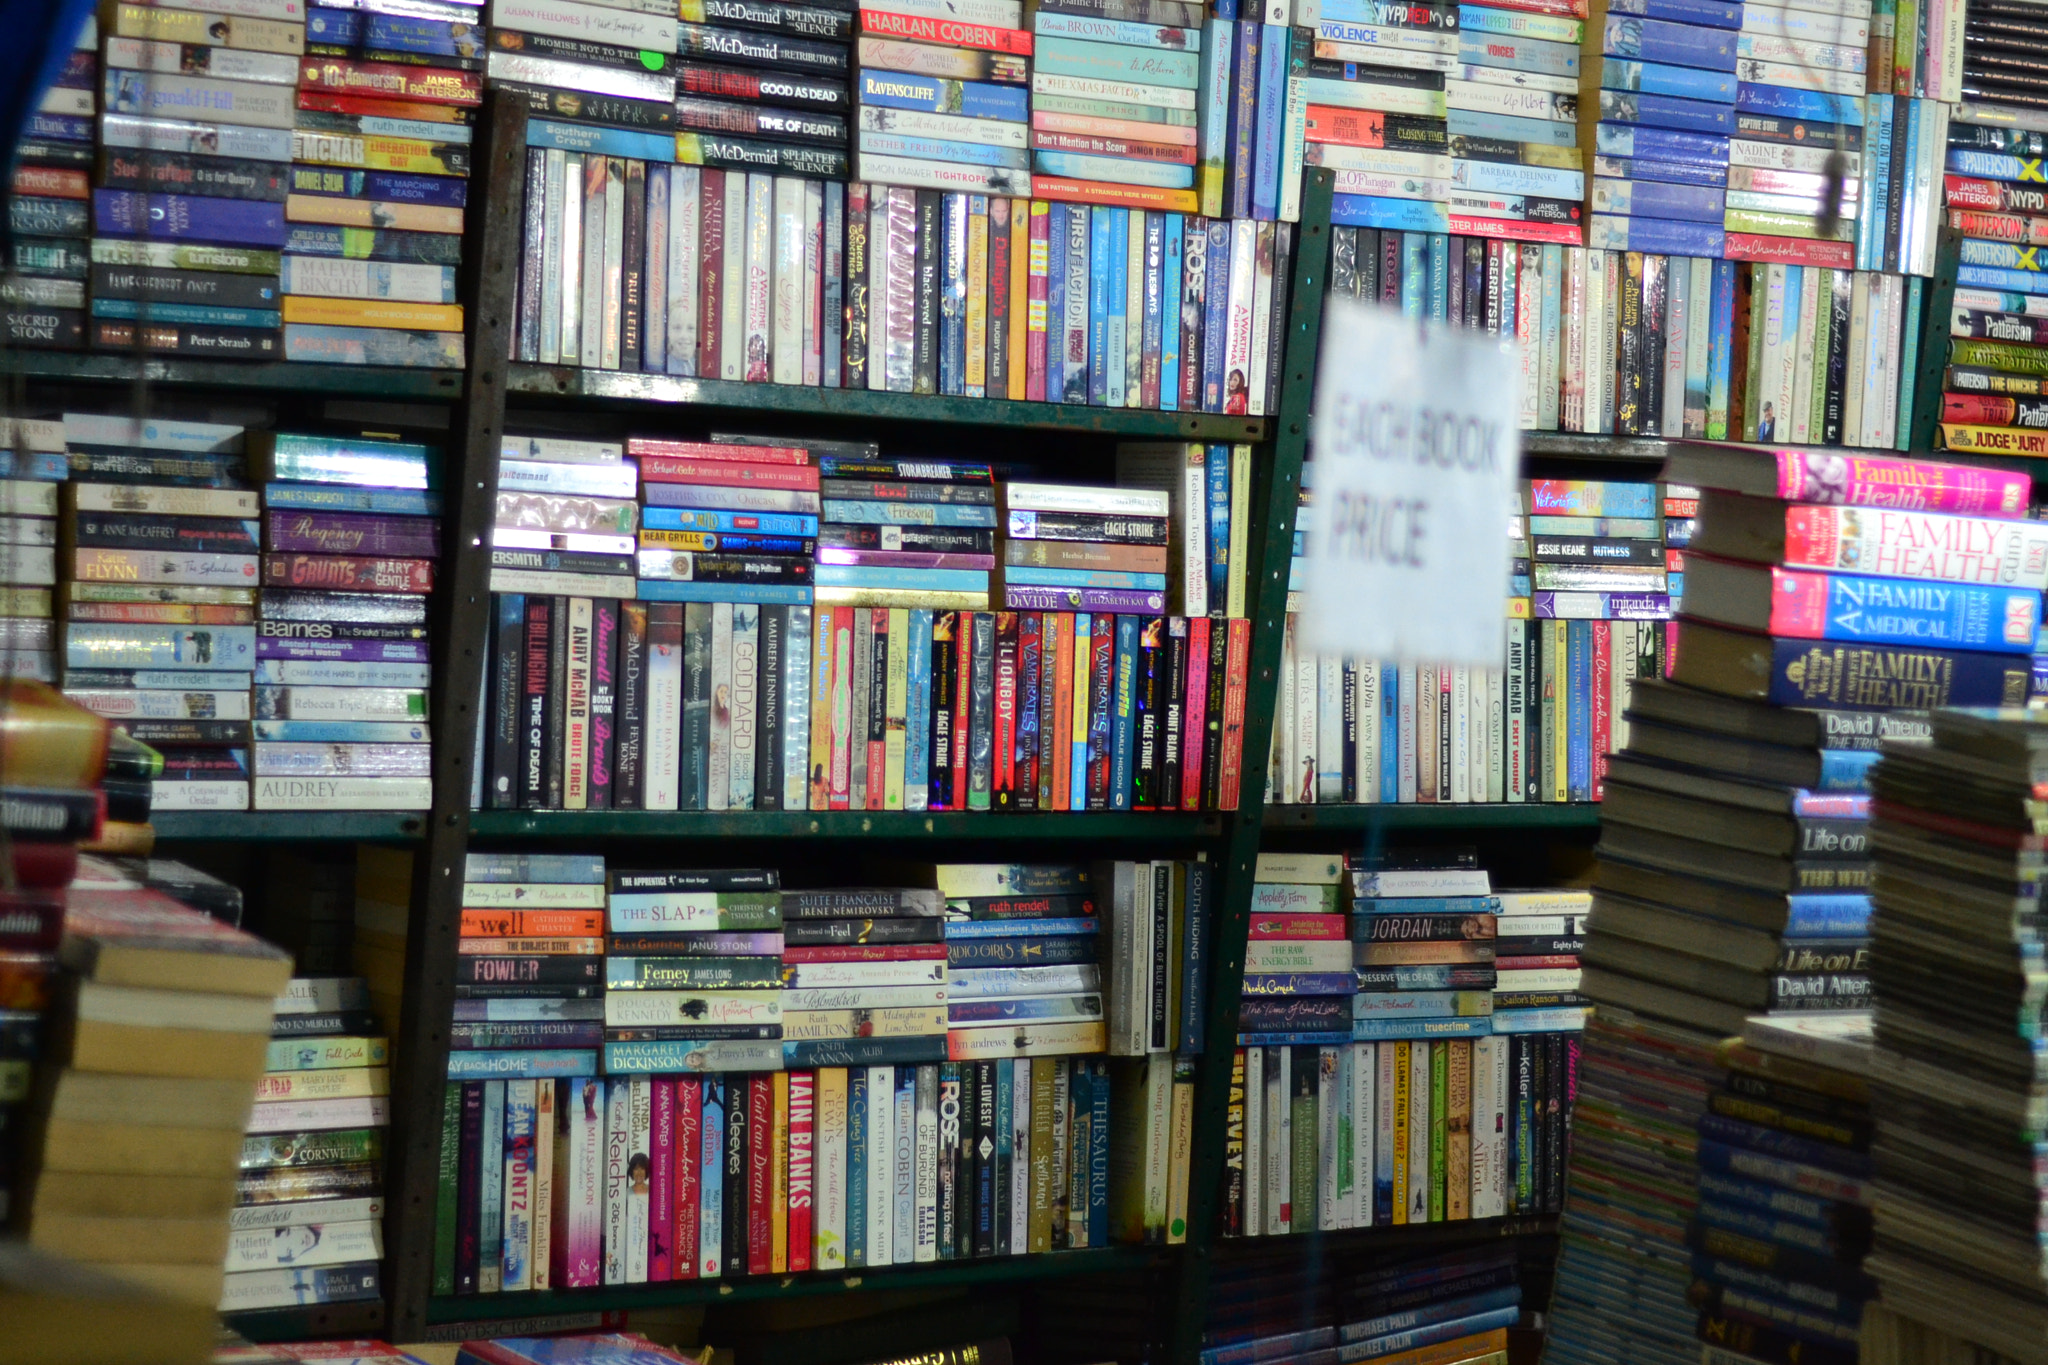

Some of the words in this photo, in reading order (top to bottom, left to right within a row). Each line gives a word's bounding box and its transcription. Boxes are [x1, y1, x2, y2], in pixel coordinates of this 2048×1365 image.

[715, 2, 780, 24] McDermid
[786, 10, 838, 26] SPLINTER
[794, 22, 837, 36] SILENCE
[868, 14, 936, 37] HARLAN
[941, 23, 997, 47] COBEN
[1321, 26, 1377, 42] VIOLENCE
[711, 37, 777, 59] McDermid
[409, 85, 476, 99] PATTERSON
[423, 75, 462, 89] JAMES
[760, 82, 793, 96] GOOD
[795, 88, 806, 98] AS
[808, 89, 837, 102] DEAD
[758, 116, 783, 131] TIME
[785, 120, 800, 133] OF
[802, 123, 837, 136] DEATH
[555, 134, 591, 147] Cross
[1038, 133, 1060, 147] Don't
[1061, 136, 1090, 153] Mention
[1091, 138, 1105, 151] the
[1106, 138, 1127, 154] Score
[1736, 144, 1777, 159] NADINE
[712, 148, 778, 166] McDermid
[782, 151, 836, 164] SPLINTER
[934, 170, 987, 184] TIGHTROPE
[1959, 182, 1988, 193] JAMES
[1537, 203, 1559, 212] JAMES
[1948, 191, 2000, 205] PATTERSON
[704, 186, 712, 263] HANCOCK
[712, 199, 721, 251] SHEILA
[1528, 209, 1567, 219] PATTERSON
[1071, 209, 1084, 258] FIRST
[921, 266, 932, 325] black-eyed
[1070, 267, 1083, 328] ACTION
[190, 335, 214, 347] Peter
[217, 336, 251, 350] Straub
[1985, 321, 2031, 342] Patterson
[921, 328, 930, 363] susans
[1187, 334, 1195, 364] count
[1187, 366, 1195, 375] to
[1187, 377, 1195, 394] ten
[1975, 431, 2009, 448] JUDGE
[2018, 434, 2046, 451] JURY
[1854, 460, 1928, 483] Family
[1851, 484, 1926, 508] Health
[645, 532, 664, 541] BEAR
[668, 533, 700, 543] GRYLLS
[1105, 522, 1126, 537] EAGLE
[1128, 524, 1154, 538] STRIKE
[1332, 490, 1431, 568] PRICE
[1880, 513, 2003, 554] FAMILY
[86, 565, 138, 579] FLYNN
[375, 561, 411, 574] MARY
[1875, 547, 2000, 582] HEALTH
[375, 574, 411, 587] GENTLE
[1869, 584, 1951, 610] FAMILY
[263, 620, 332, 638] Barnes
[1865, 616, 1949, 639] MEDICAL
[573, 627, 587, 663] ANDY
[768, 618, 777, 671] MAUREEN
[528, 623, 547, 693] BILLINGHAM
[1511, 642, 1522, 672] ANDY
[1861, 652, 1943, 681] FAMILY
[626, 642, 639, 720] McDermid
[1858, 680, 1941, 706] HEALTH
[734, 642, 753, 749] GODDARD
[766, 674, 776, 728] JENNINGS
[531, 697, 542, 726] TIME
[937, 710, 948, 735] EAGLE
[1168, 704, 1178, 732] POINT
[1143, 714, 1154, 738] EAGLE
[1827, 715, 1873, 734] David
[531, 729, 541, 747] OF
[571, 723, 582, 758] BRUTE
[629, 726, 638, 760] FEVER
[1166, 735, 1177, 763] BLANC
[936, 738, 948, 767] STRIKE
[1142, 741, 1153, 769] STRIKE
[529, 749, 539, 790] DEATH
[734, 753, 743, 781] Count
[263, 782, 338, 797] AUDREY
[570, 763, 581, 797] FORCE
[621, 910, 647, 920] THE
[651, 906, 695, 921] SLAP
[989, 902, 1011, 912] ruth
[1014, 900, 1049, 912] rendell
[480, 913, 524, 935] well
[1372, 918, 1432, 939] JORDAN
[643, 964, 689, 979] Ferney
[1777, 977, 1824, 995] David
[613, 1045, 681, 1056] MARGARET
[614, 1055, 682, 1069] DICKINSON
[1520, 1058, 1530, 1097] Keller
[732, 1089, 742, 1109] Ann
[791, 1076, 812, 1121] IAIN
[980, 1085, 992, 1126] LOVESEY
[824, 1089, 833, 1143] LEWIS
[900, 1093, 910, 1133] Harlan
[940, 1082, 959, 1149] ROSE
[729, 1112, 744, 1174] Cleeves
[920, 1125, 927, 1140] OF
[1092, 1098, 1107, 1206] THESAURUS
[609, 1132, 626, 1198] Reichs
[790, 1133, 811, 1208] BANKS
[898, 1136, 909, 1195] COBEN
[919, 1144, 927, 1198] BURUNDI
[538, 1180, 548, 1211] Miles
[537, 1214, 547, 1259] Franklin
